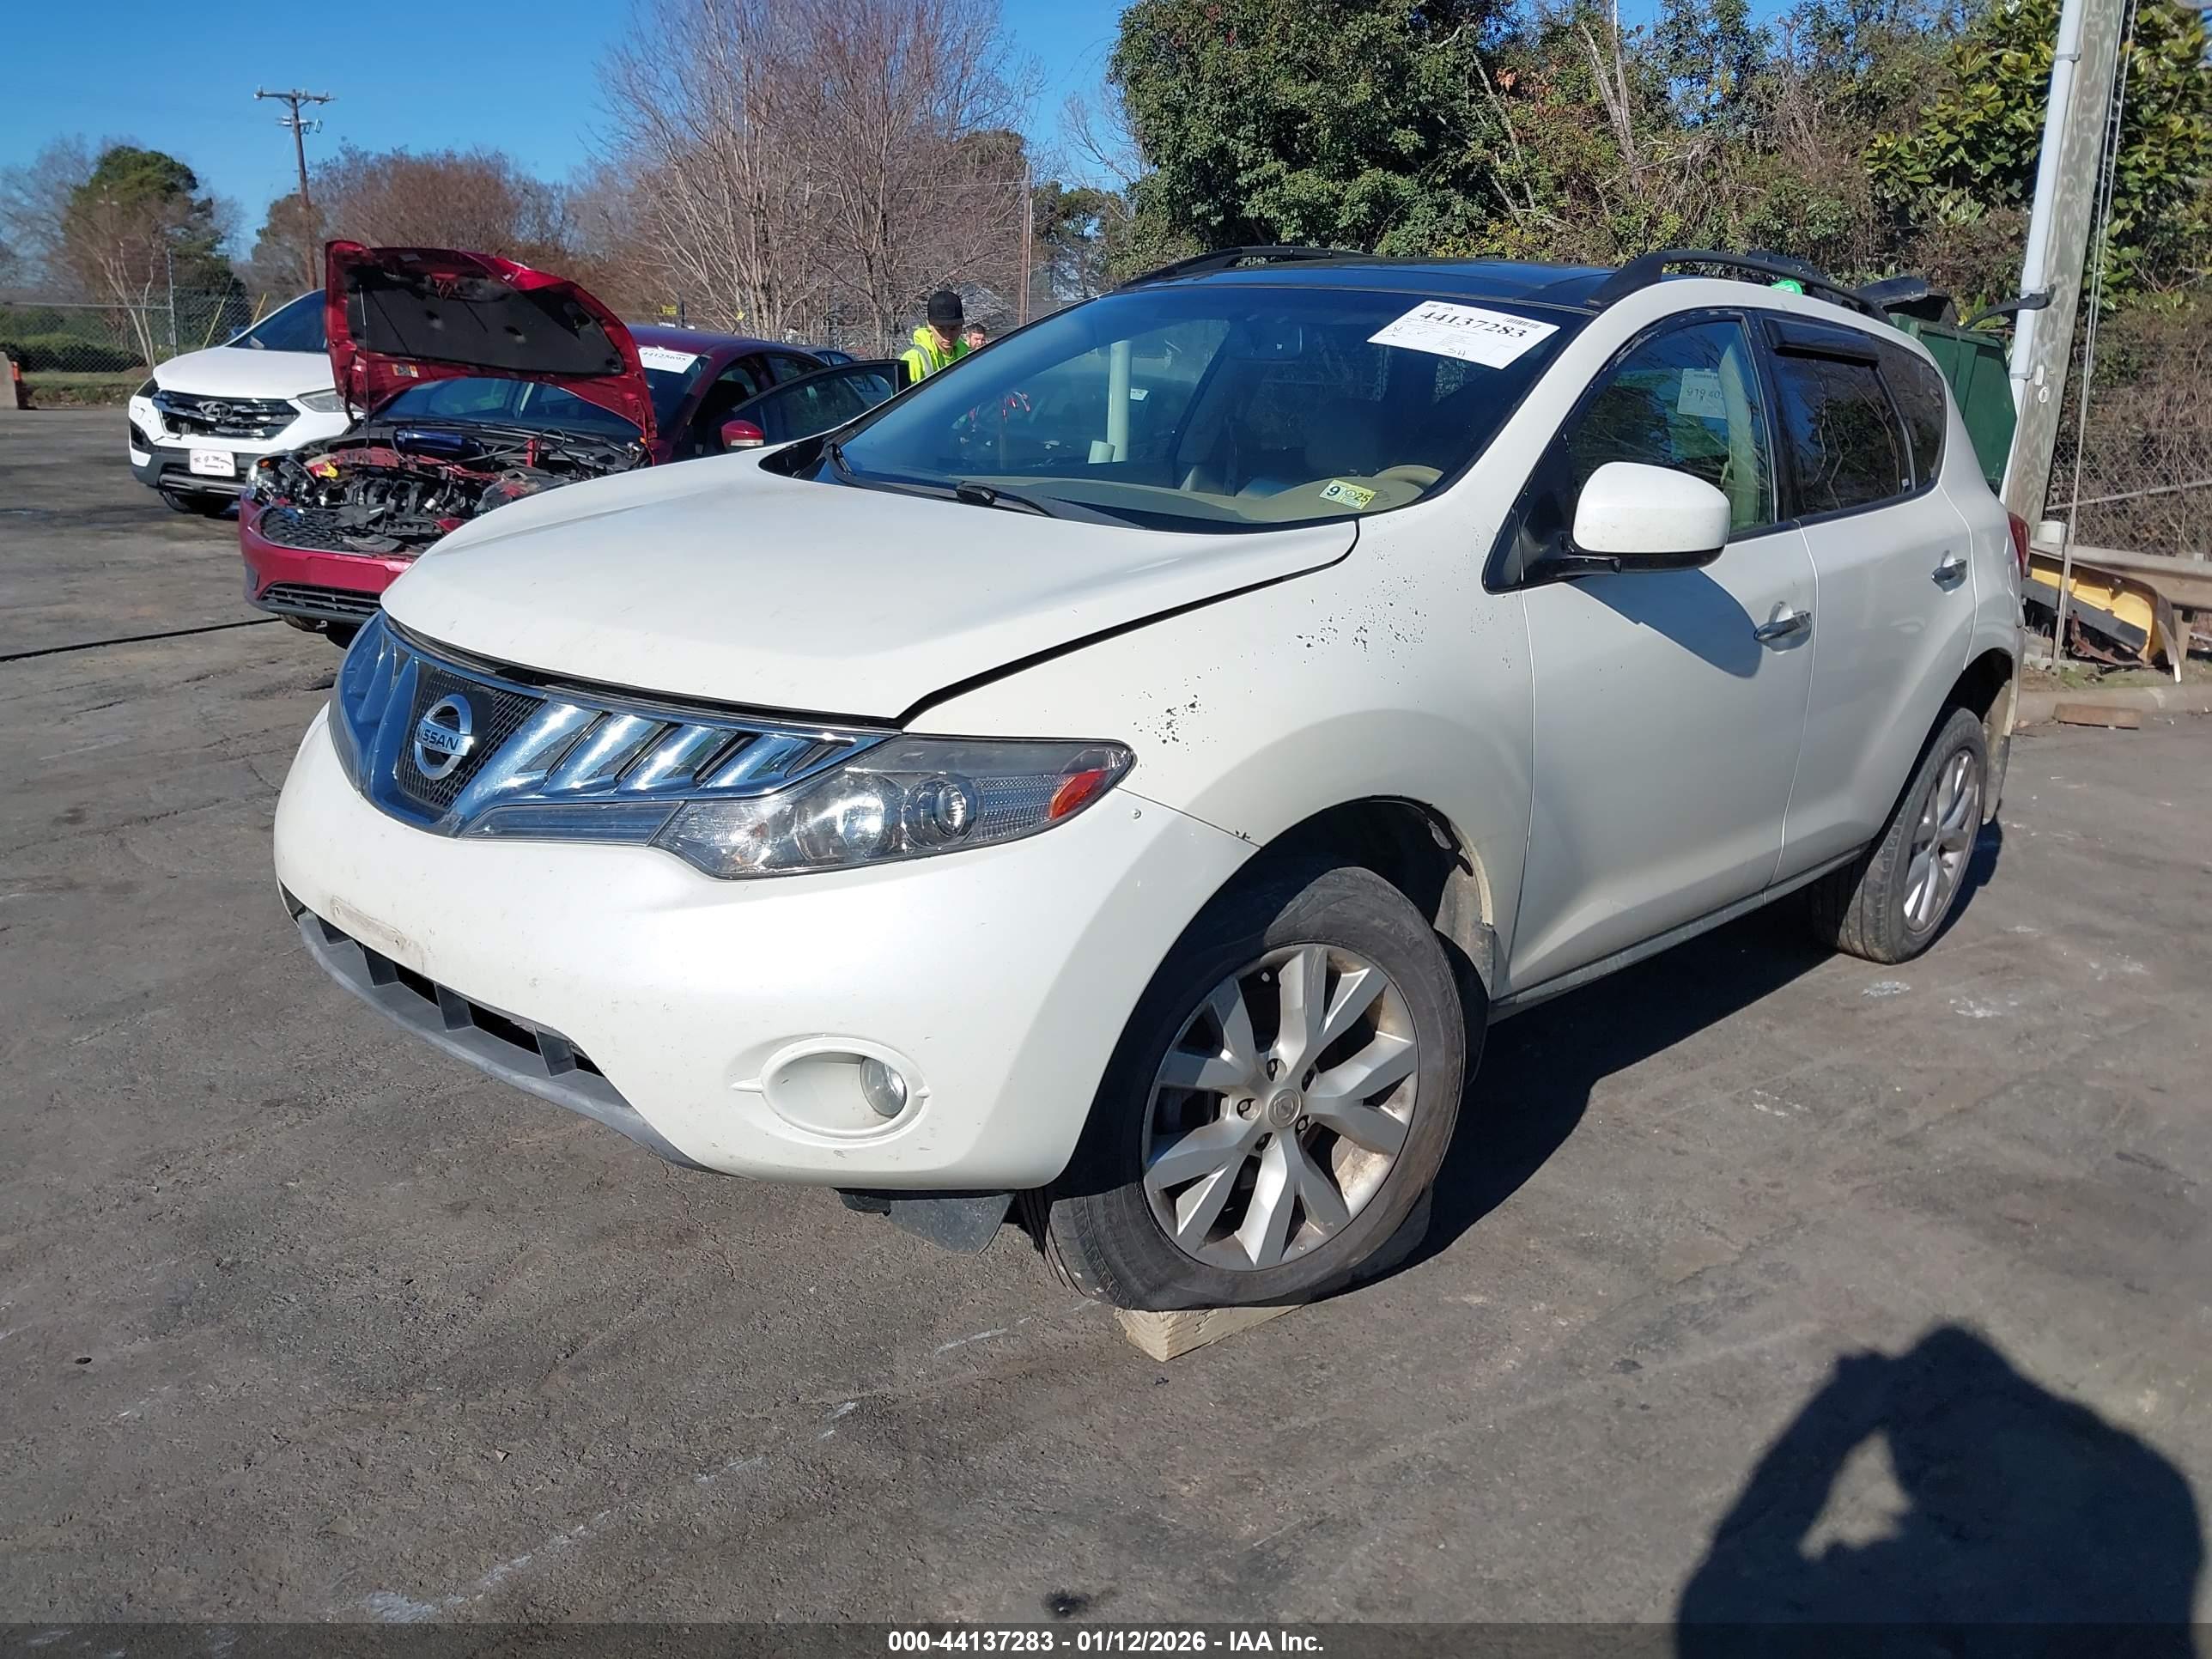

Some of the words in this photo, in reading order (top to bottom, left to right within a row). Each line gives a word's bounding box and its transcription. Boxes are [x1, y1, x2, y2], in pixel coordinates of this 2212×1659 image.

[1419, 312, 1528, 338] 44137283
[1326, 486, 1340, 496] 9
[1355, 492, 1370, 503] 25
